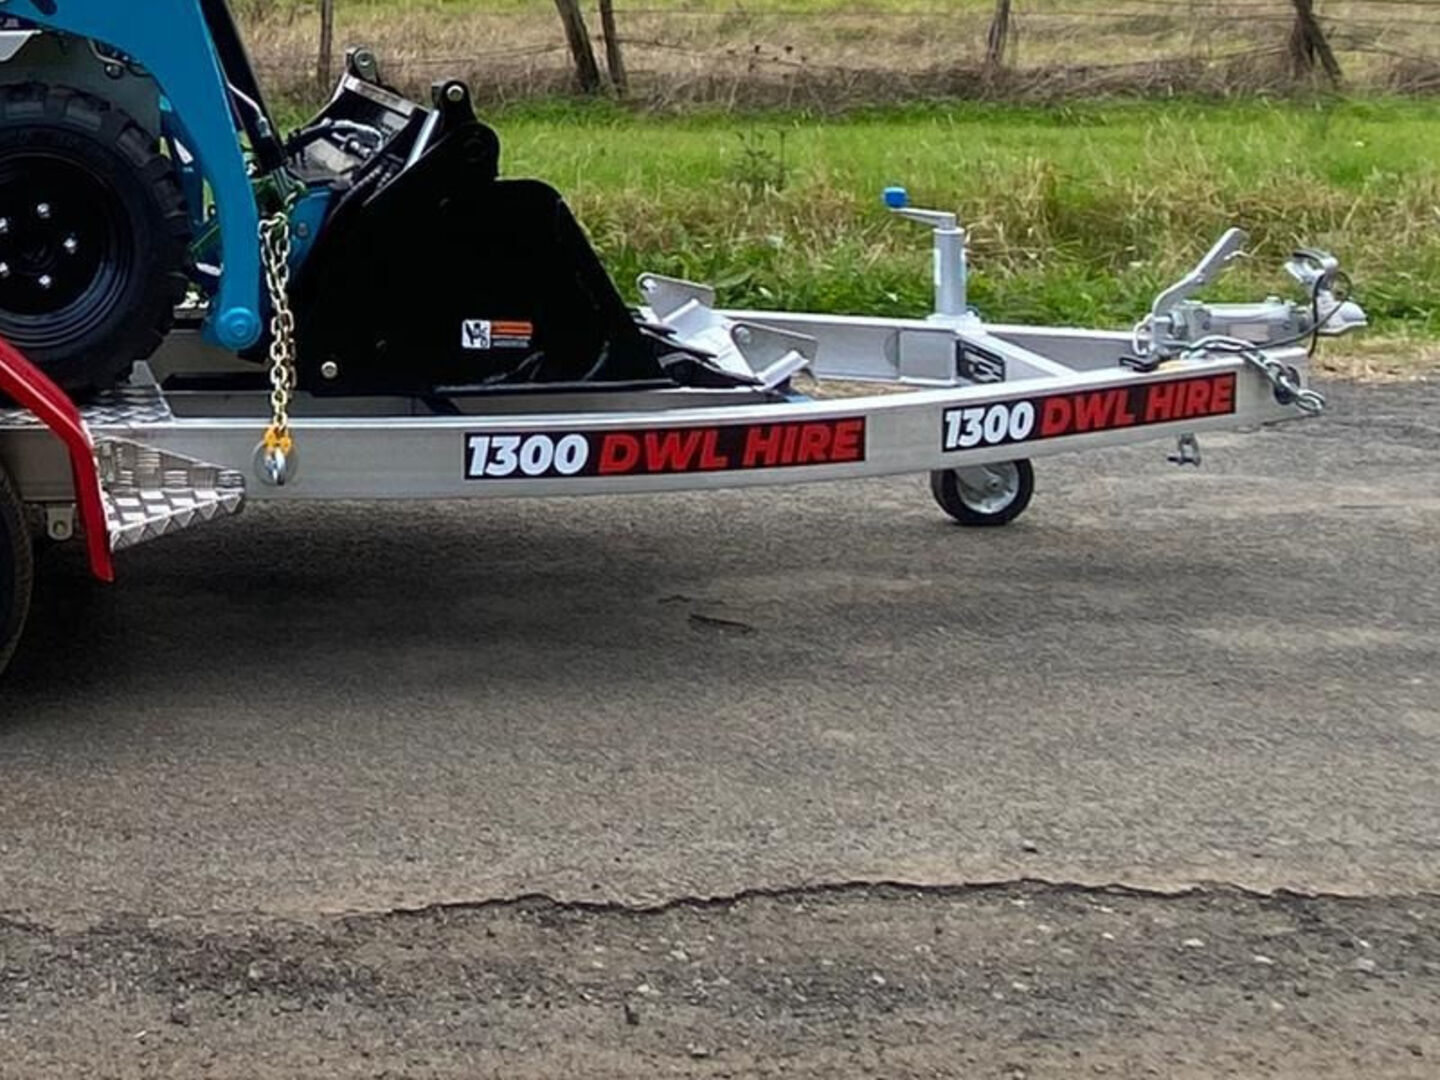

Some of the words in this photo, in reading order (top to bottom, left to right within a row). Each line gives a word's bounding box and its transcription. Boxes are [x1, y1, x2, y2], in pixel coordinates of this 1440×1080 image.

[945, 400, 1036, 449] 1300
[1040, 388, 1136, 436] DWL
[1144, 375, 1234, 421] HIRE
[467, 433, 589, 477] 1300
[598, 430, 728, 474] DWL
[740, 420, 863, 466] HIRE
